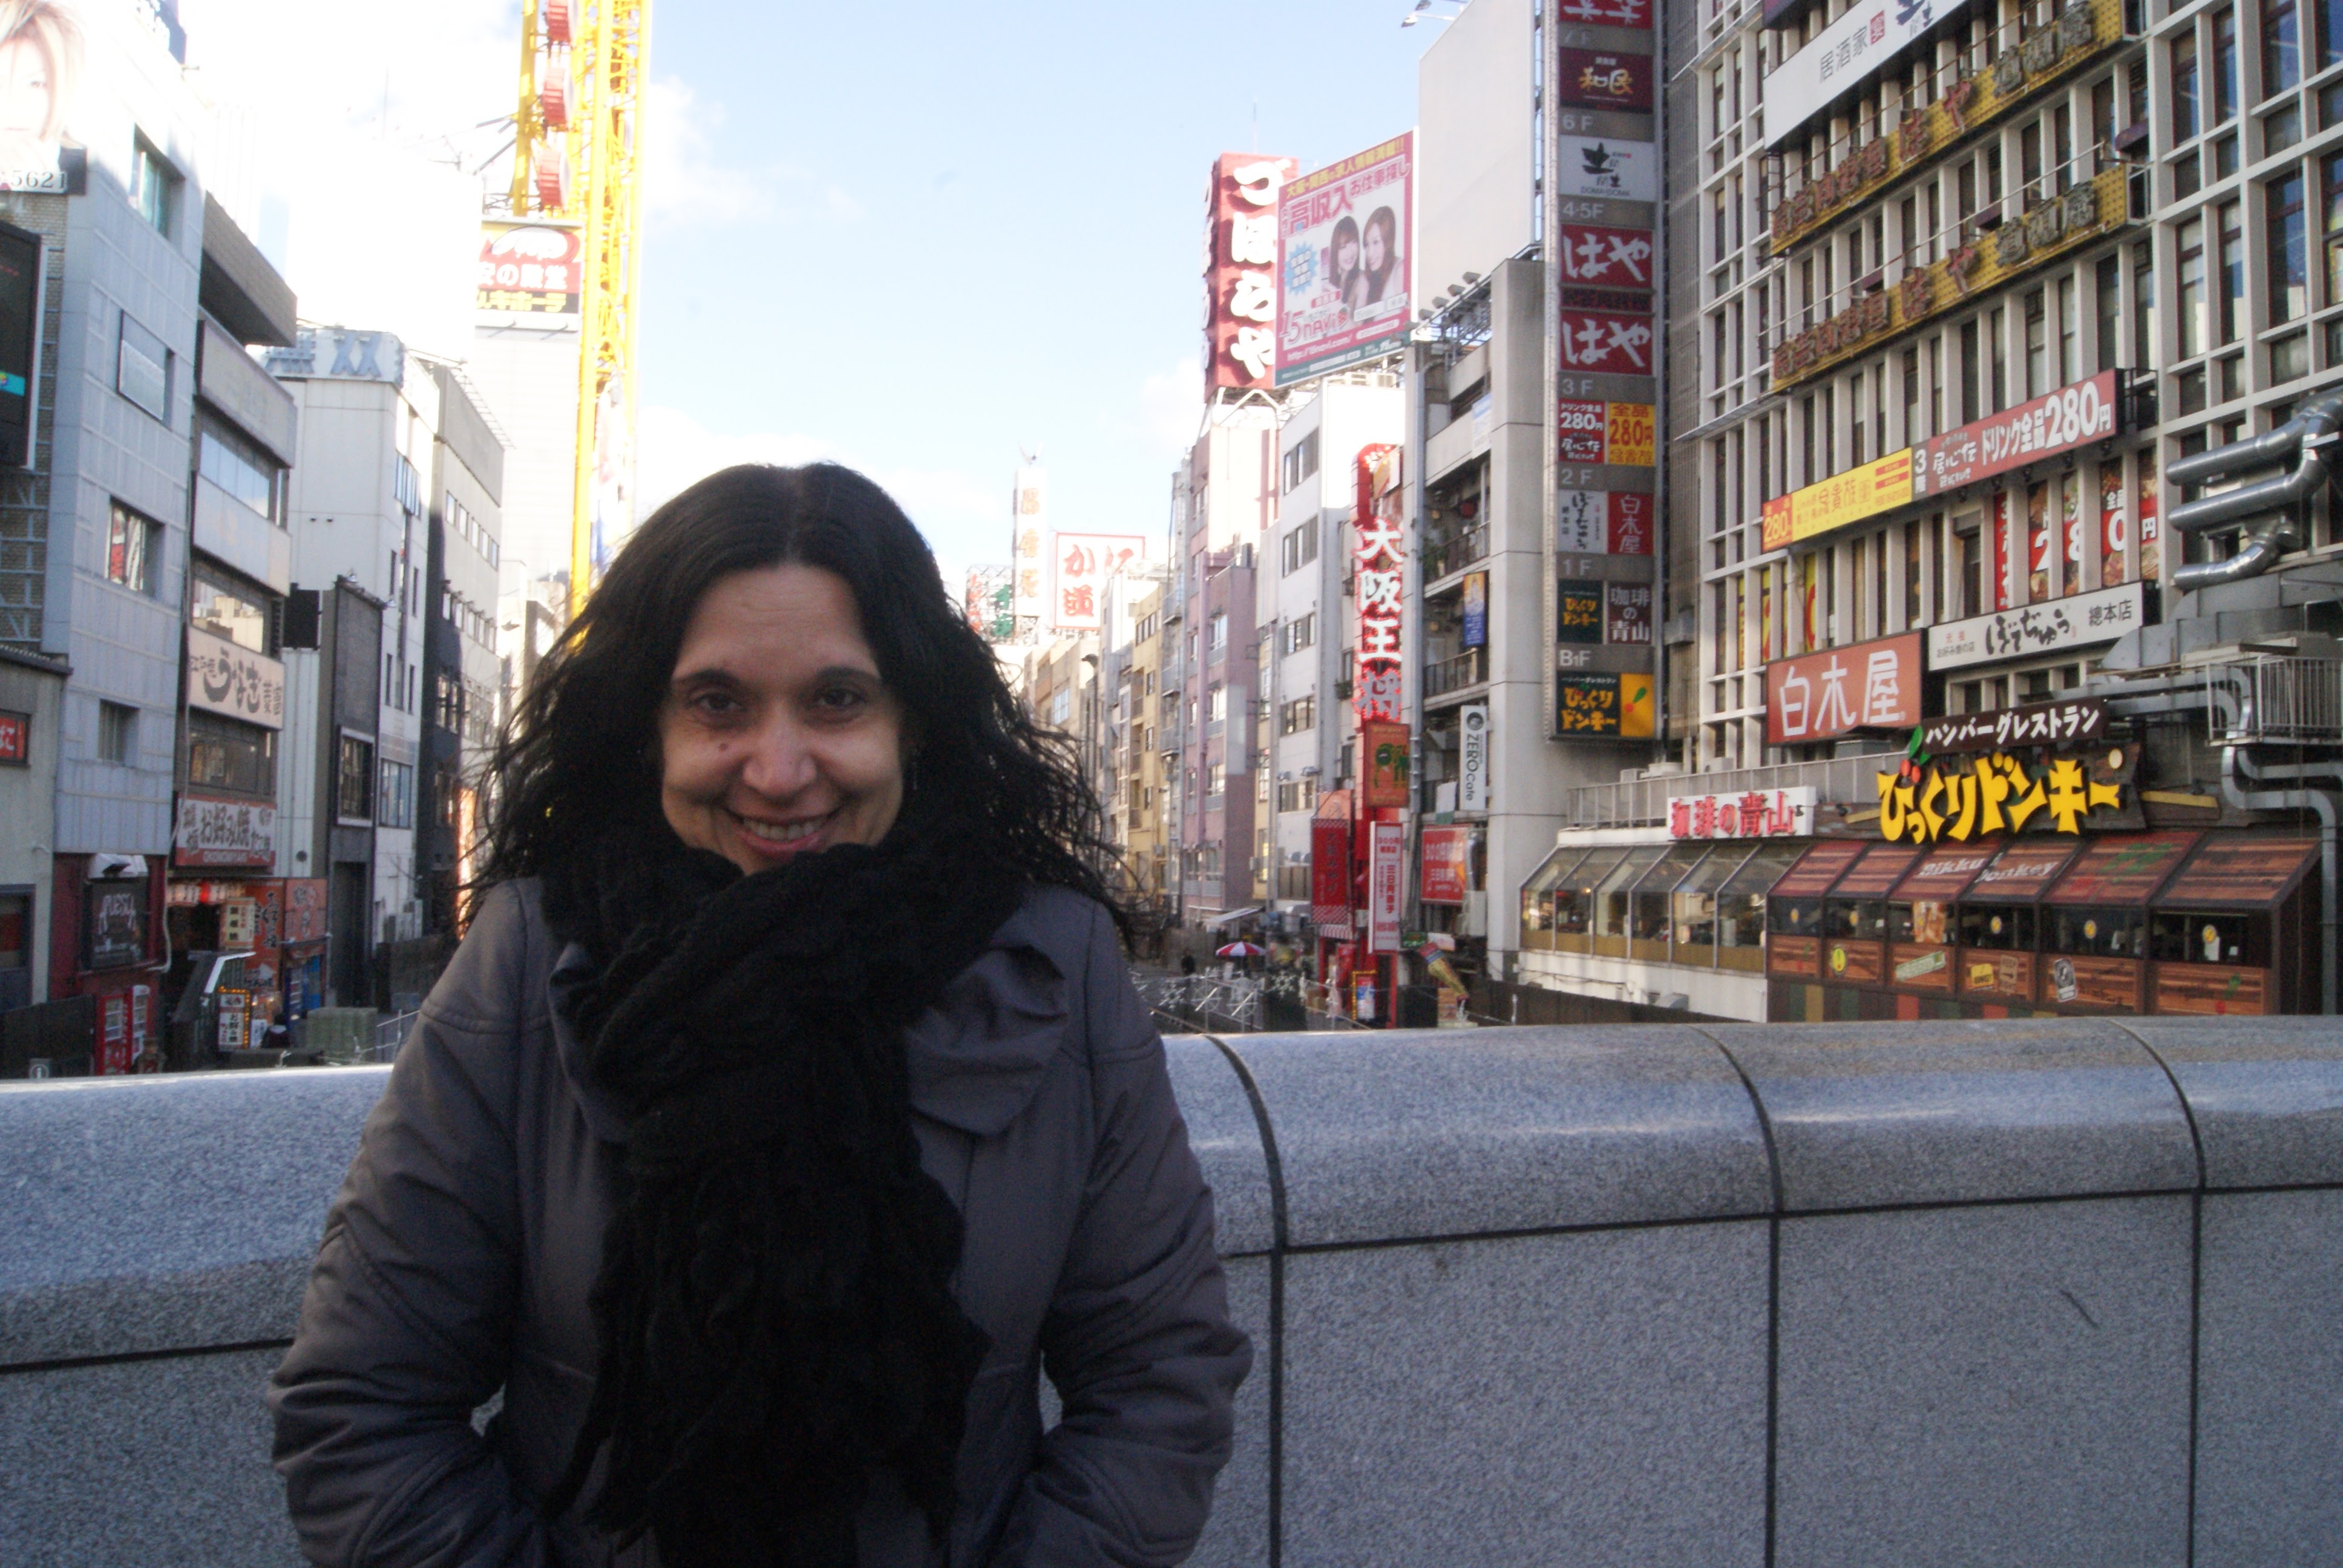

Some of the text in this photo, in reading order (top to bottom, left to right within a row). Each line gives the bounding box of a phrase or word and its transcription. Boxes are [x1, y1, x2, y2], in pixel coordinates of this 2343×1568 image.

[1562, 114, 1593, 131] 6F
[1562, 232, 1651, 282] はや
[1562, 318, 1651, 367] はや
[1562, 378, 1594, 396] 3F
[1561, 468, 1593, 485] 2F
[1618, 494, 1643, 553] 白木屋
[1564, 559, 1592, 576] 1F
[1622, 607, 1637, 619] の
[1610, 619, 1650, 642] 青山
[1564, 687, 1614, 710] びっくり
[1779, 649, 1901, 736] 白木屋
[1561, 708, 1617, 731] ドンキー
[1925, 704, 2100, 748] ハンバーグレストラン
[1466, 734, 1479, 773] ZERO
[1876, 753, 2120, 845] びっくりドンキー
